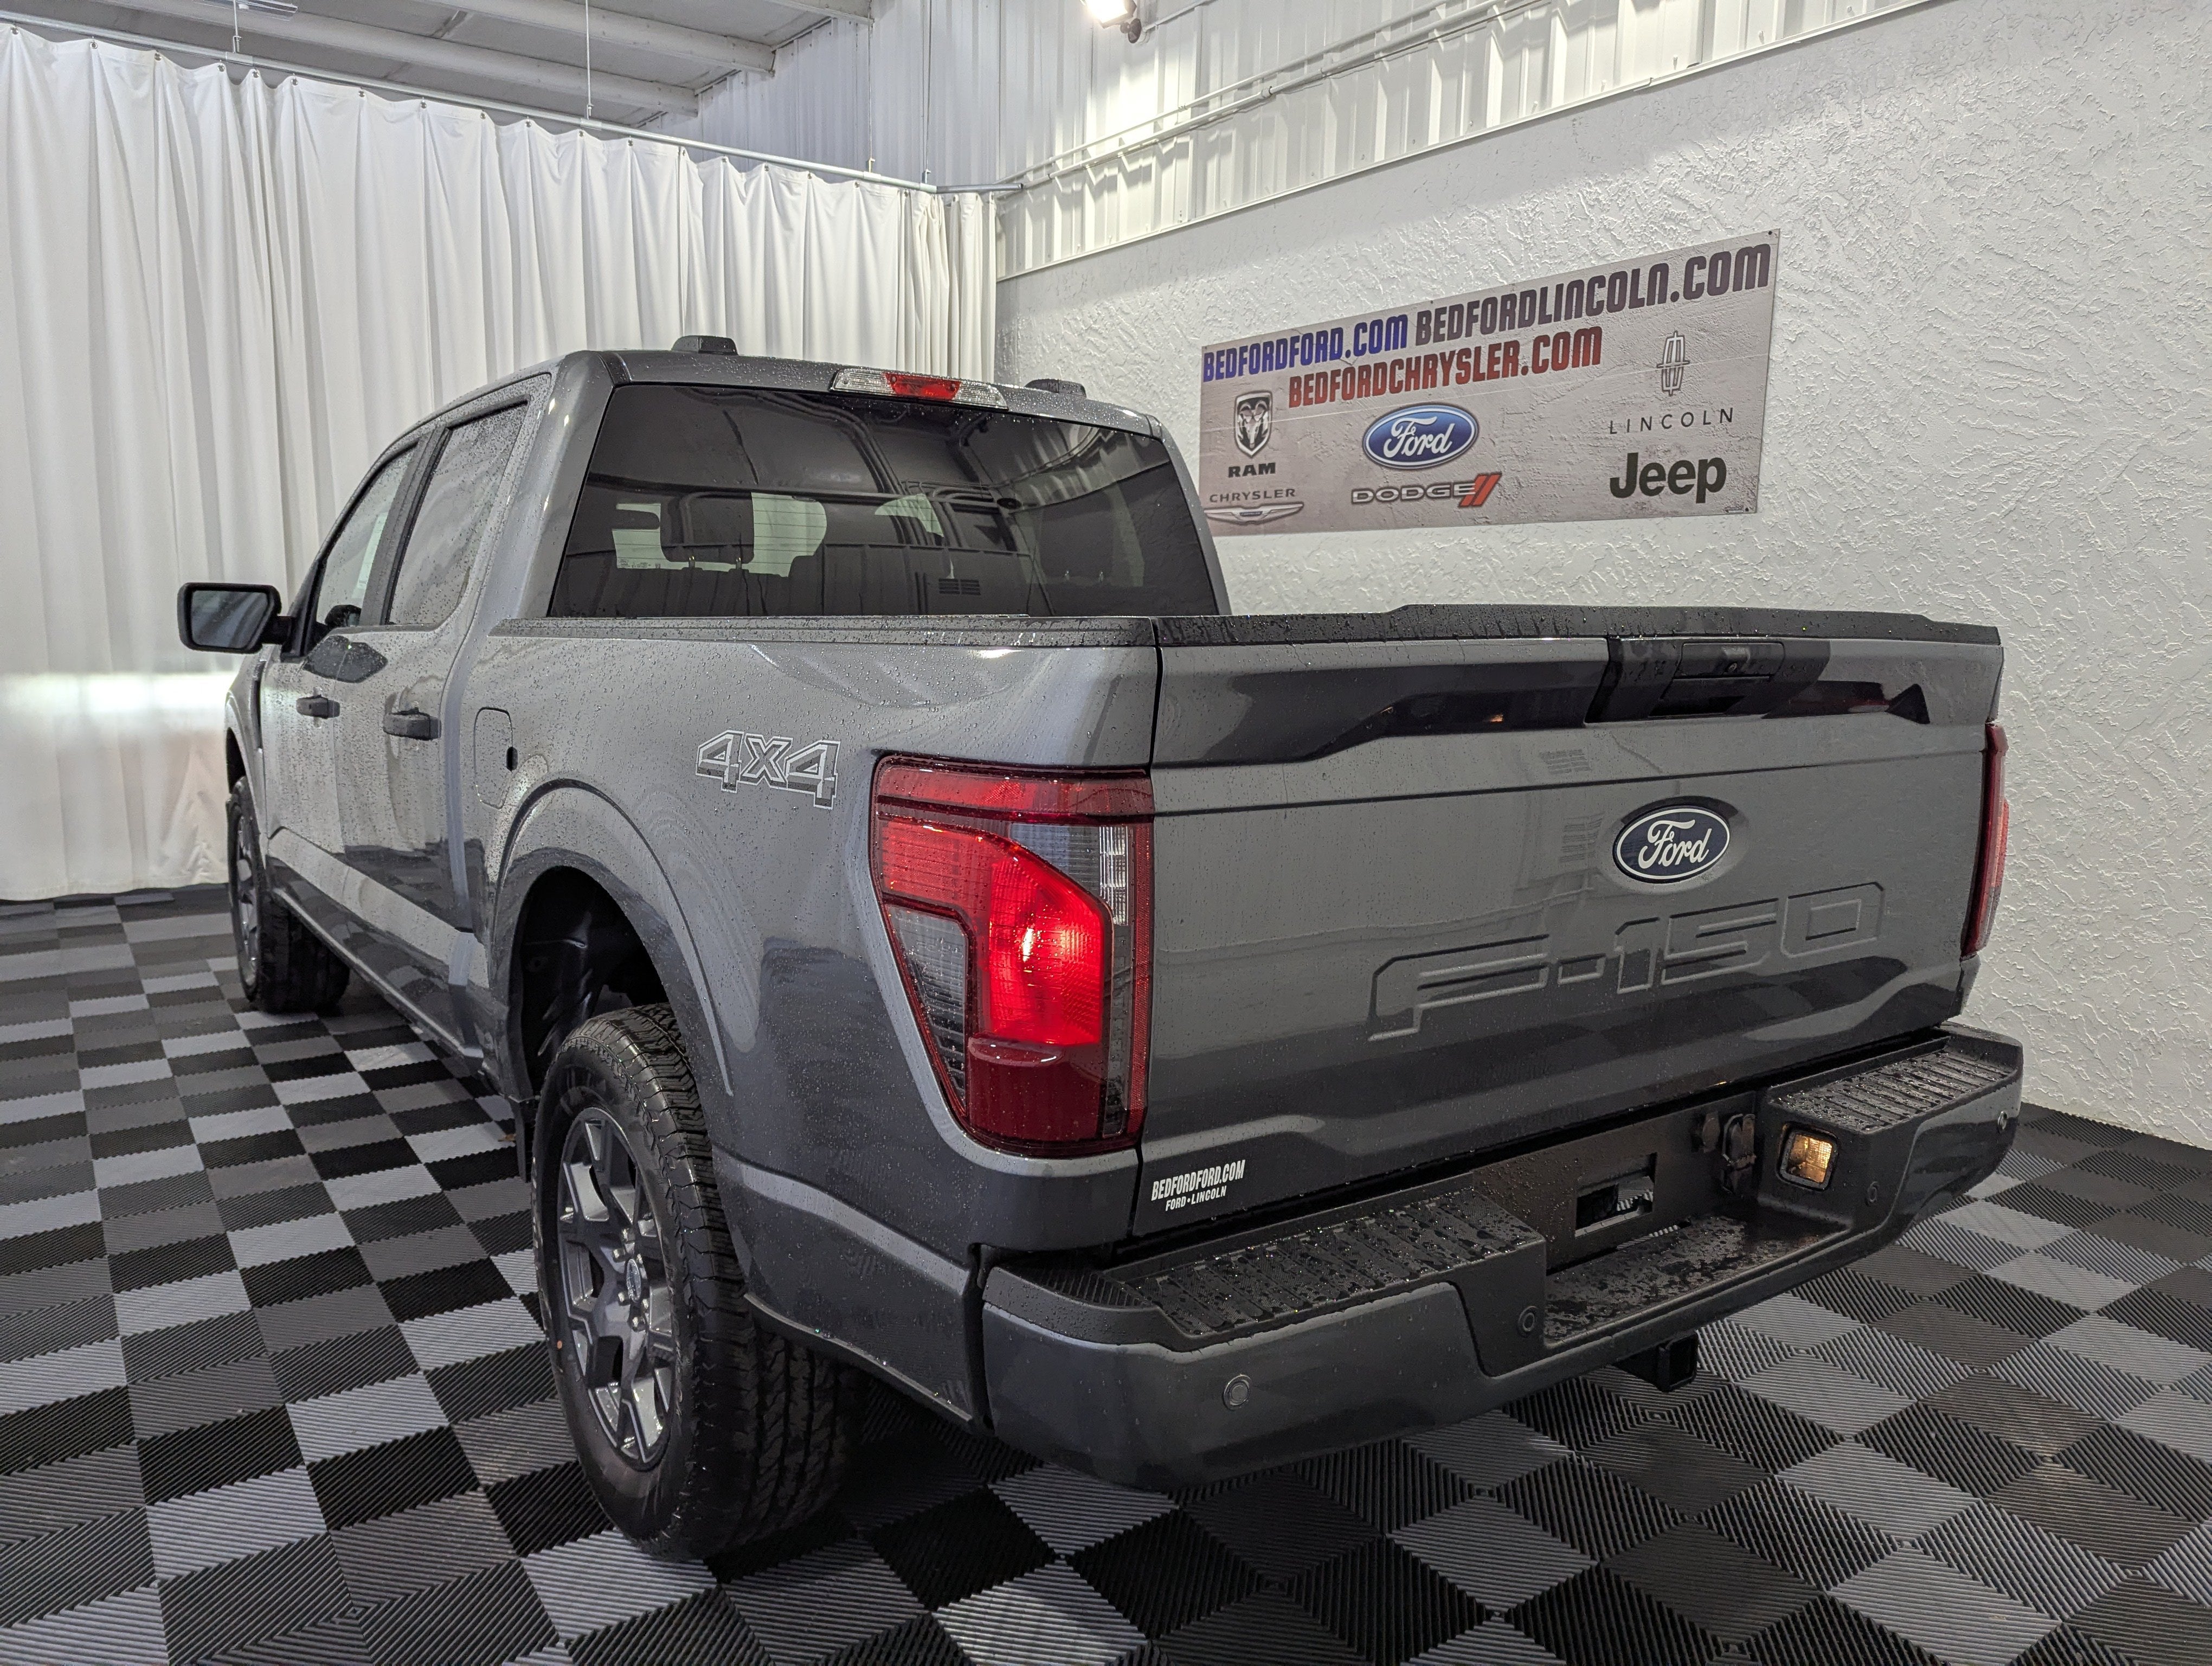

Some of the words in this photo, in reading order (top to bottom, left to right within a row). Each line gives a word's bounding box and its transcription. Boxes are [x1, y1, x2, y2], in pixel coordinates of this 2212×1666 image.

[1203, 315, 1409, 382] BEDFORDFORD.COM
[1416, 244, 1771, 347] BEDFORDLINCOLN.COM
[1289, 326, 1603, 408] BEDFORDCHRYSLER.COM
[1383, 416, 1455, 458] Ford
[1610, 408, 1733, 434] LINCOLN
[1228, 463, 1276, 478] RAM
[1610, 452, 1727, 504] Jeep
[1210, 489, 1296, 503] CHRYSLER
[1352, 482, 1477, 504] DODGE
[1638, 819, 1713, 869] Ford
[1368, 881, 1885, 1042] F-150
[1151, 1159, 1246, 1201] BEDFORDFORD.COM
